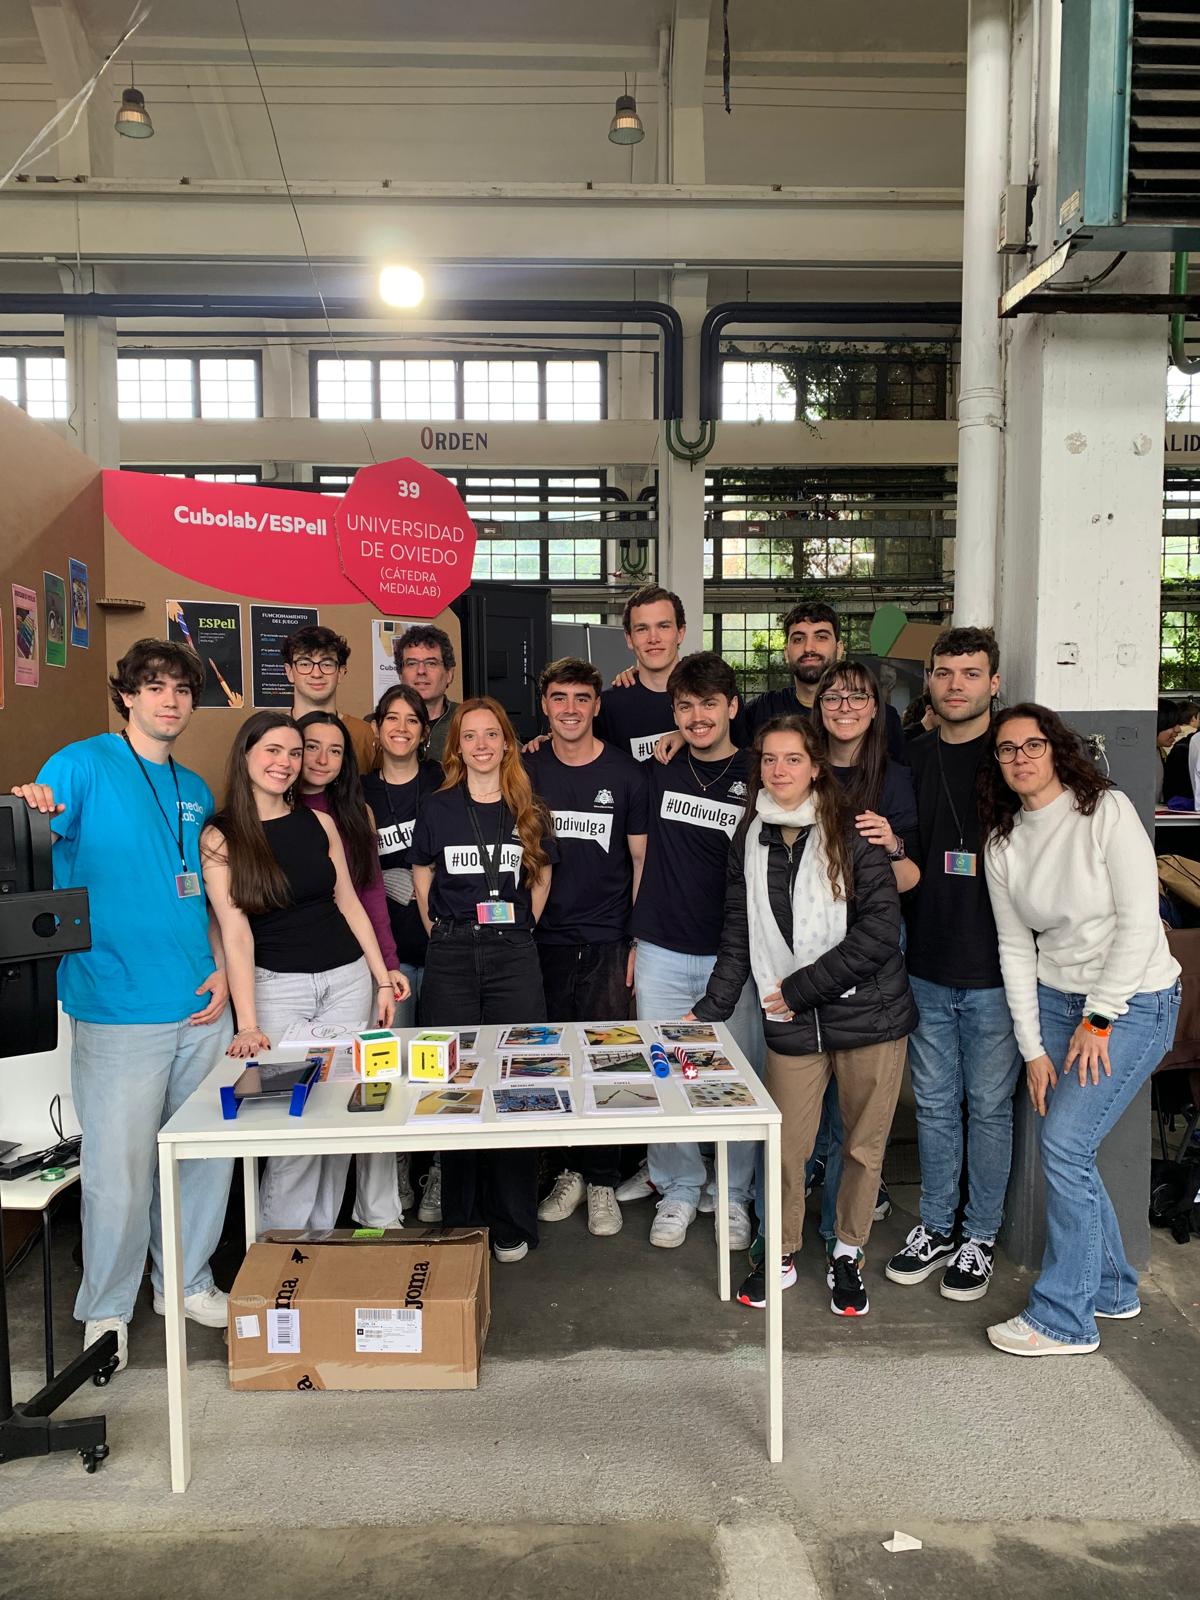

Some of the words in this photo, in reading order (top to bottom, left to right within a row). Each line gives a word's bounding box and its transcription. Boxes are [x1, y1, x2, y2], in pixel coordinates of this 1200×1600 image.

[421, 426, 488, 450] ORDEN
[1165, 434, 1200, 452] LID
[398, 480, 420, 499] 39
[174, 505, 327, 536] Cubolab/ESPell
[347, 514, 464, 543] UNIVERSIDAD
[360, 540, 384, 559] DE
[390, 543, 458, 566] OVIEDO
[380, 566, 437, 583] (CÁTEDRA
[379, 582, 441, 599] MEDIALAB)
[198, 617, 236, 629] ESPell
[666, 798, 737, 827] #UOdivulga
[552, 816, 606, 836] Odivulga
[275, 1277, 299, 1310] ma
[404, 1260, 430, 1310] Joma
